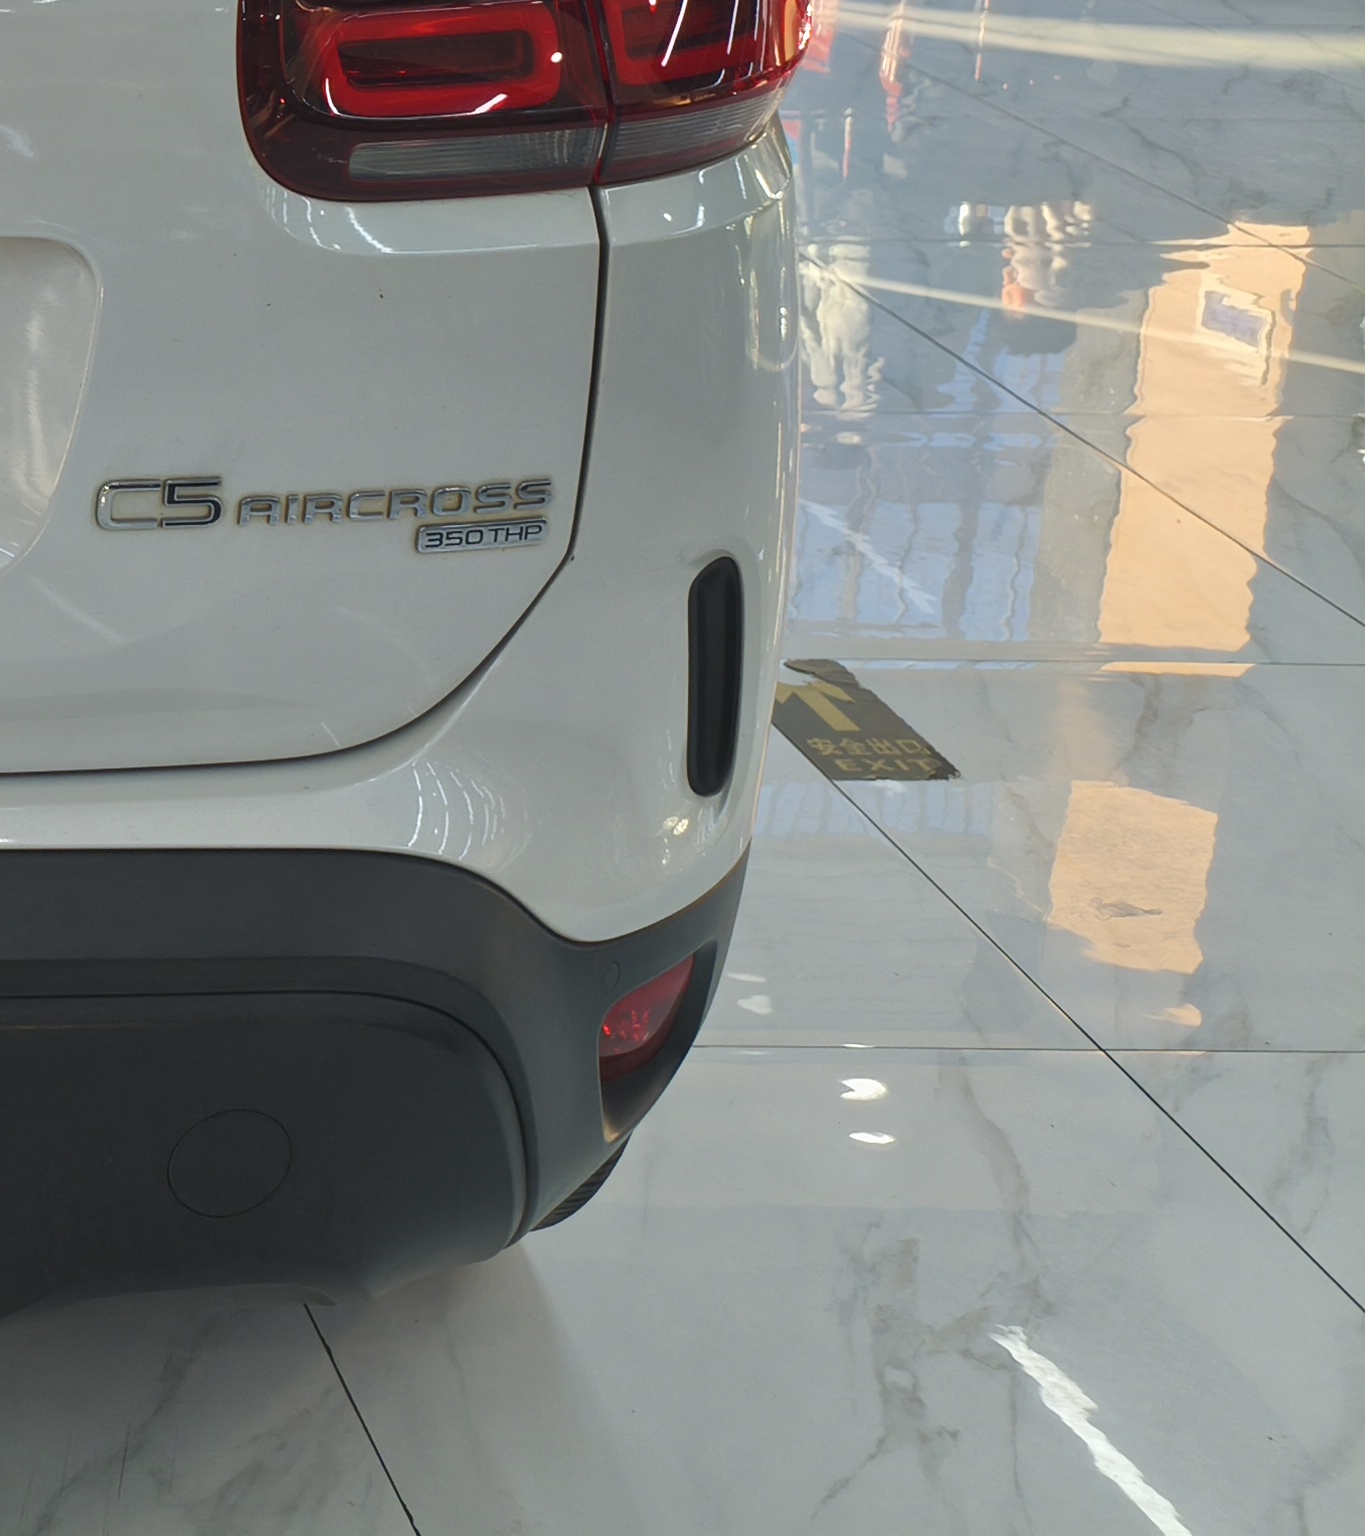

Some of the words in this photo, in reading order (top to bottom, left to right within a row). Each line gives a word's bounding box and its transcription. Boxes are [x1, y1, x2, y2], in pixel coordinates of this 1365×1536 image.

[95, 476, 224, 531] C5
[236, 478, 555, 527] AIRCROSS
[833, 758, 941, 773] EXIT
